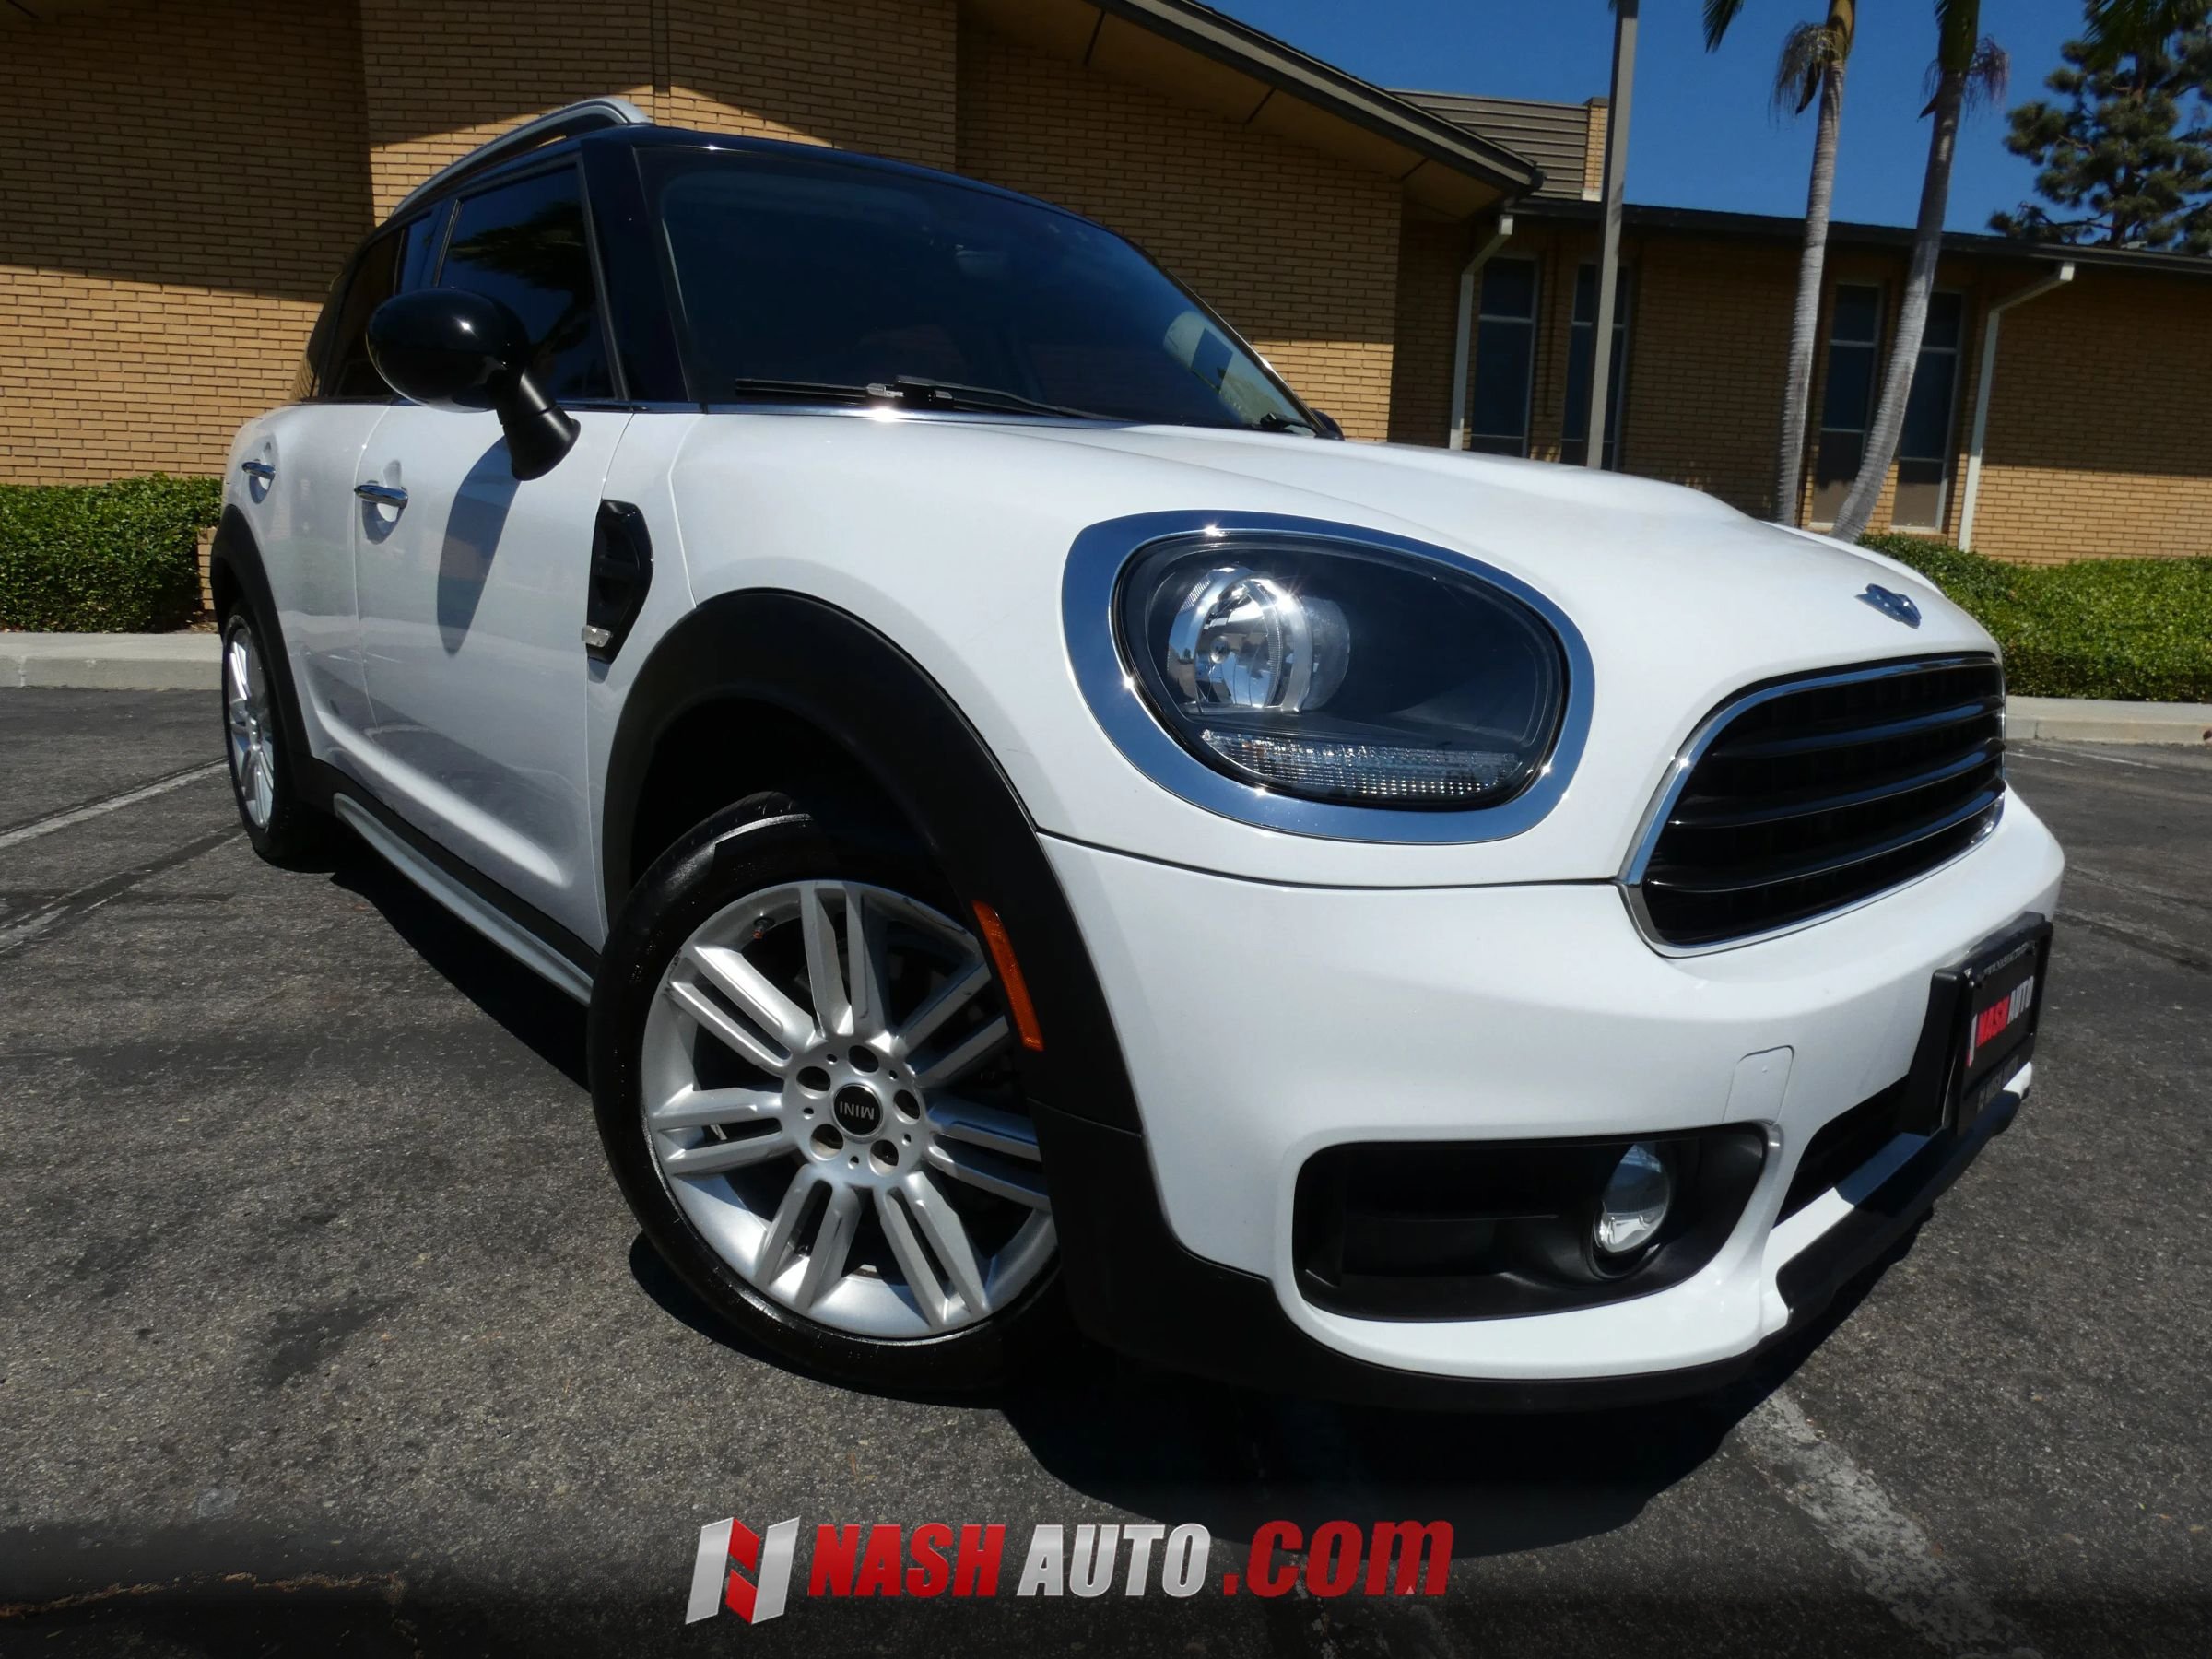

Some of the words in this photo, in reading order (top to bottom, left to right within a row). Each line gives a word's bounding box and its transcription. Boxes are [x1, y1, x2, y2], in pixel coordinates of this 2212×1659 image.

[1975, 994, 2010, 1048] NASH
[2006, 975, 2034, 1026] AUTO
[839, 1100, 875, 1121] MINI
